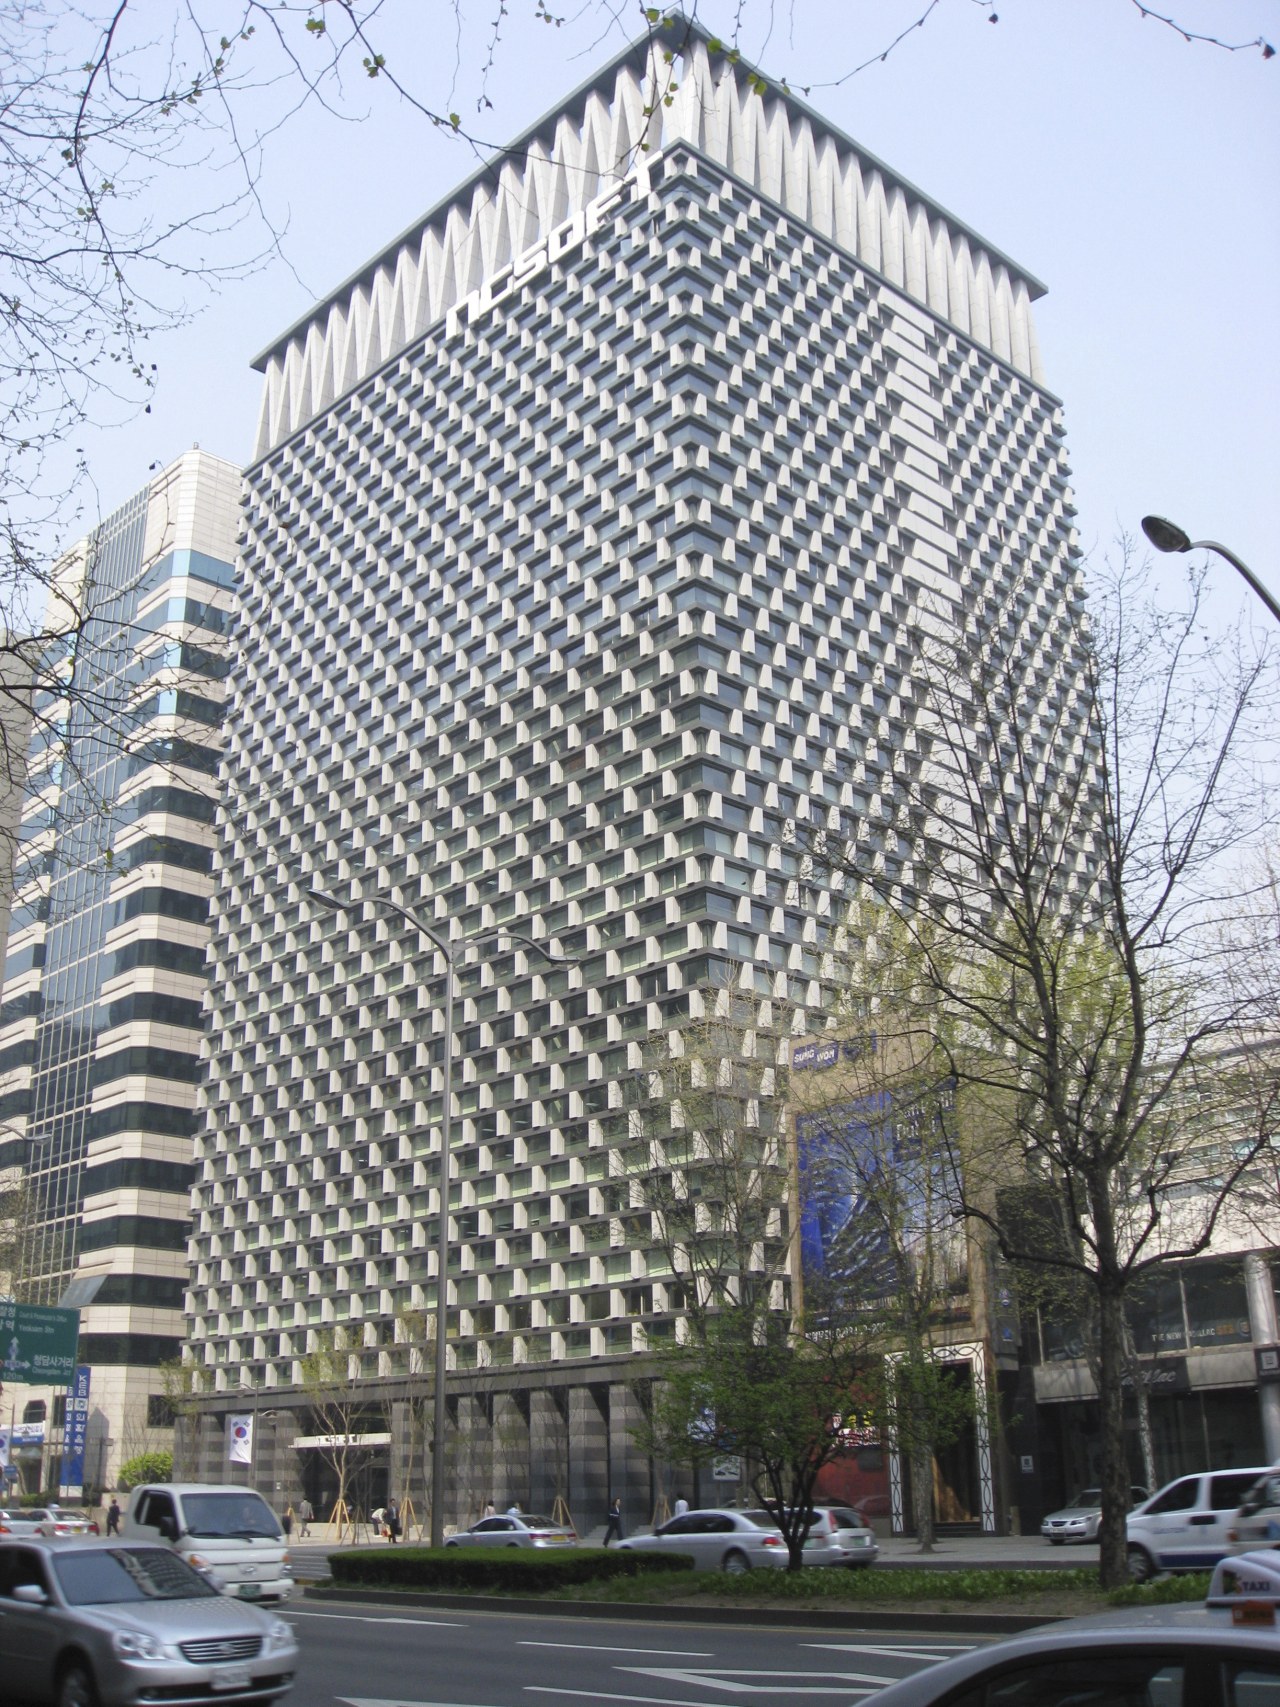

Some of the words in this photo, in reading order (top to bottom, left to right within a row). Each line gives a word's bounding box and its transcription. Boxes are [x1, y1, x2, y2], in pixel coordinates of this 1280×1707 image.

[33, 1354, 74, 1368] 청담사거리
[78, 1374, 87, 1397] KEB
[1242, 1581, 1270, 1592] TAXI
